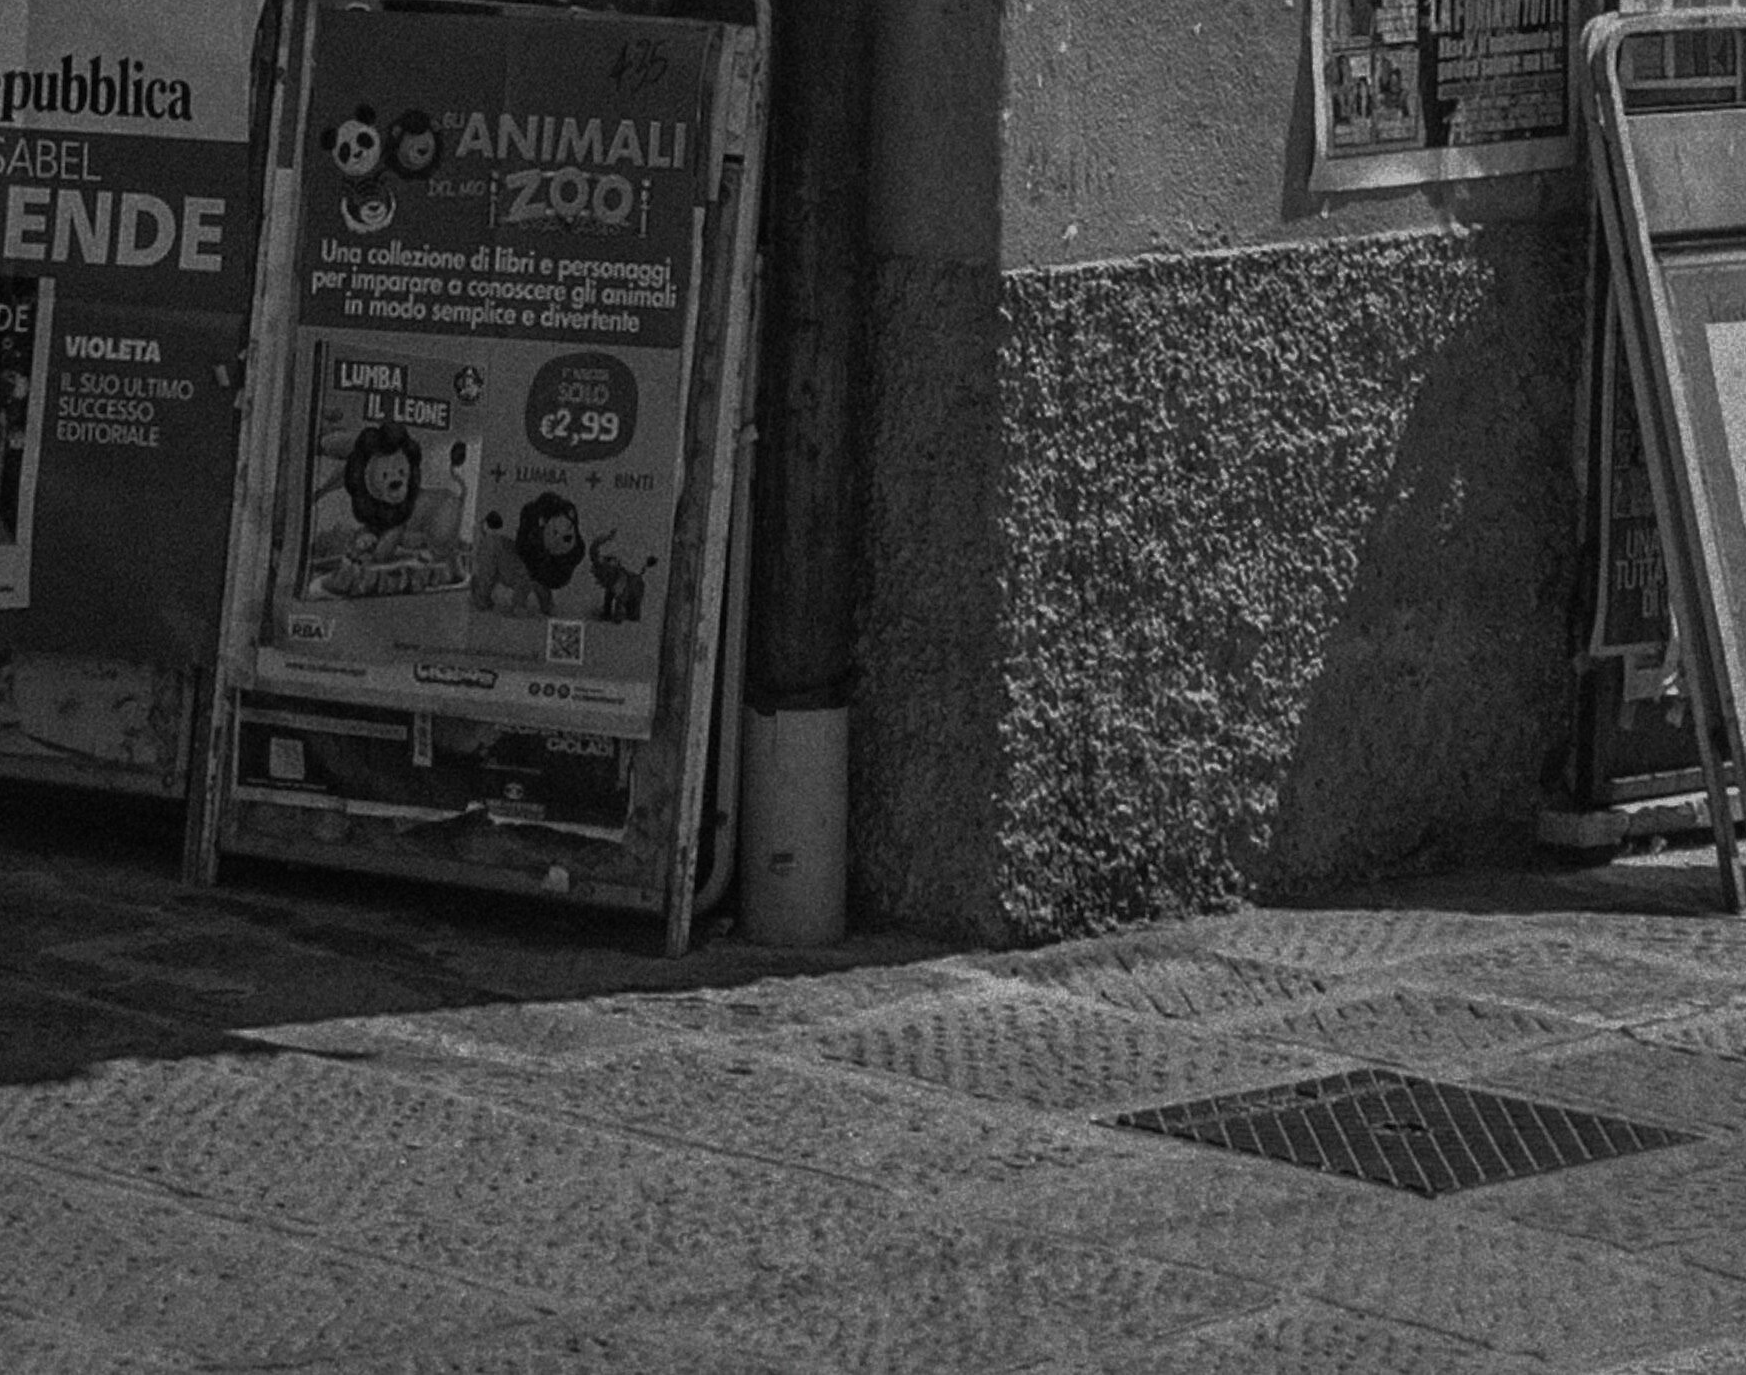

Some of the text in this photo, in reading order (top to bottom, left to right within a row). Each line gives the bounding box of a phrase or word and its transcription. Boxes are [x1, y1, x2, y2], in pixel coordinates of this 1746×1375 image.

[454, 111, 687, 170] ANIMALI
[501, 166, 636, 225] ZOO
[320, 239, 672, 287] Una collezione di libri e personaggi
[311, 266, 678, 309] per imparare a conoscere gli animali
[344, 290, 641, 333] in modo semplice e divertente
[64, 333, 162, 364] VIOLETA
[59, 372, 195, 402] IL SUO ULTIMO
[341, 362, 403, 391] LUMBA
[58, 395, 155, 423] SUCCESSO
[557, 384, 608, 404] SOLO
[367, 397, 449, 428] IL LEONE
[539, 410, 620, 443] €2,99
[56, 419, 160, 447] EDITORIALE
